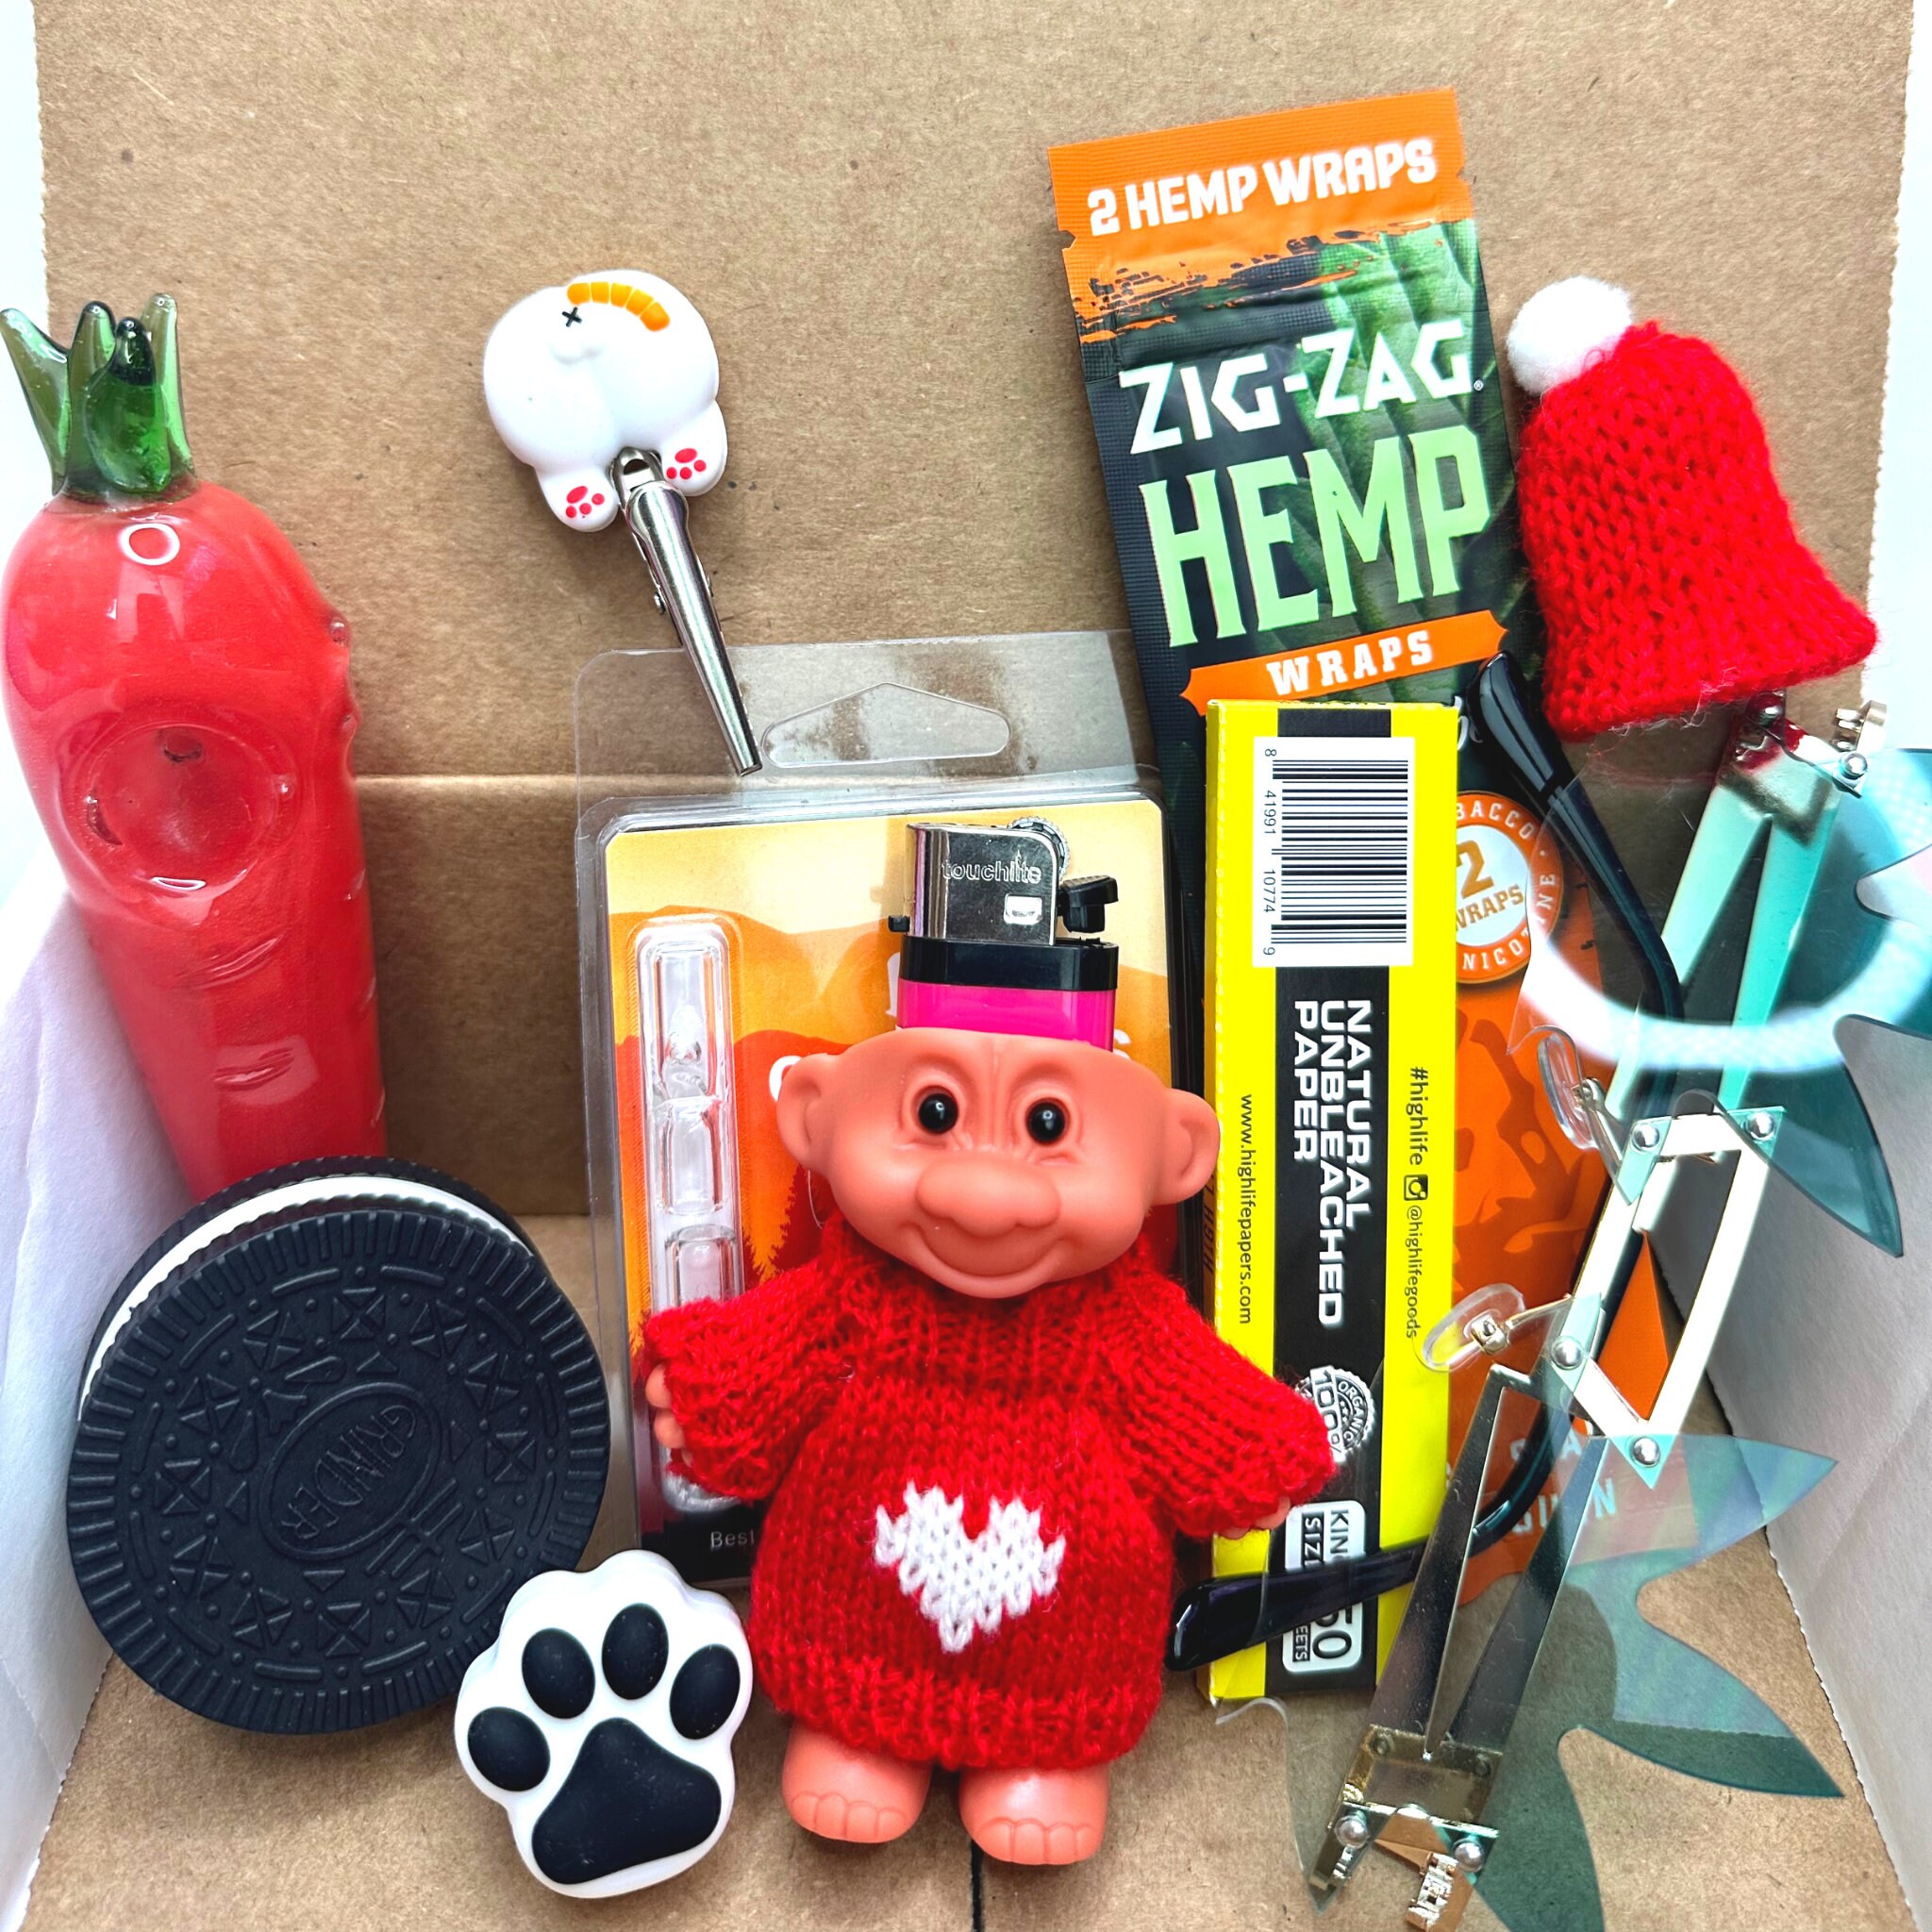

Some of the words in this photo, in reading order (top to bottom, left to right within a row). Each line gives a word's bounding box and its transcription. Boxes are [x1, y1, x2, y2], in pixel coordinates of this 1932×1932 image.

[1088, 189, 1120, 236] 2
[1127, 165, 1258, 230] HEMP
[1263, 139, 1437, 205] WRAPS
[1119, 319, 1474, 455] ZIG-ZAG
[1139, 425, 1491, 648] HEMP
[1266, 629, 1433, 695] WRAPS
[1264, 748, 1277, 757] 8
[1264, 790, 1277, 835] 41991
[1456, 800, 1536, 840] BACCO
[941, 853, 1041, 884] touchlite
[1263, 869, 1276, 913] 10774
[1457, 839, 1494, 899] 2
[1263, 946, 1275, 956] 9
[1294, 1000, 1320, 1161] PAPER
[1346, 1000, 1373, 1227] NATURAL
[1406, 1066, 1429, 1165] #highlife
[1319, 1000, 1345, 1324] UNBLEACHED
[1237, 1093, 1257, 1324] www.highlifepapers.com
[1404, 1205, 1423, 1339] @highlifegoods
[1338, 1380, 1364, 1441] ORGANIC
[282, 1405, 417, 1540] GRINDER
[1330, 1509, 1349, 1560] KIN
[1295, 1625, 1308, 1660] EETS
